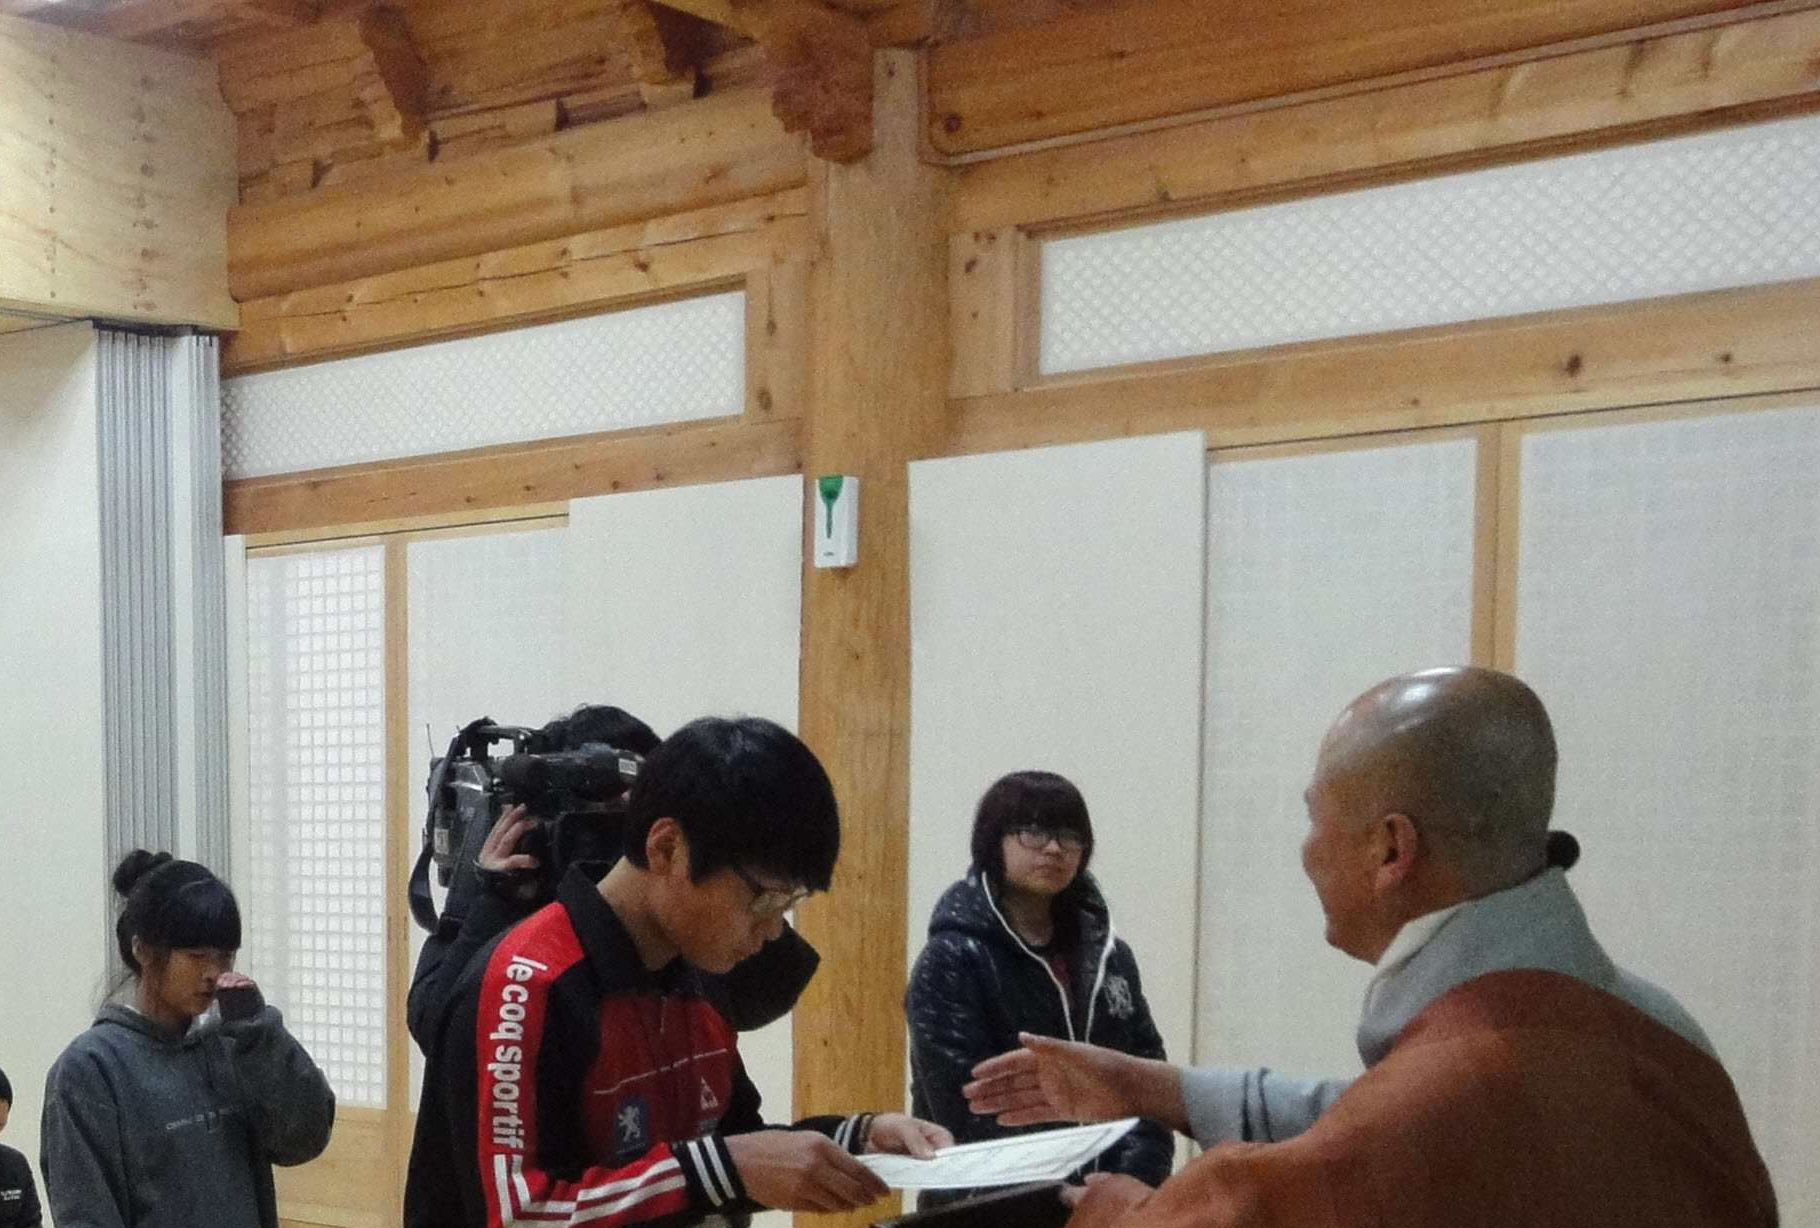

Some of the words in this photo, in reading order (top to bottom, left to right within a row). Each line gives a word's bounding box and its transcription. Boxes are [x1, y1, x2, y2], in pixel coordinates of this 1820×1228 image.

[506, 954, 549, 982] le
[489, 984, 528, 1041] coq
[487, 1045, 525, 1150] sportif
